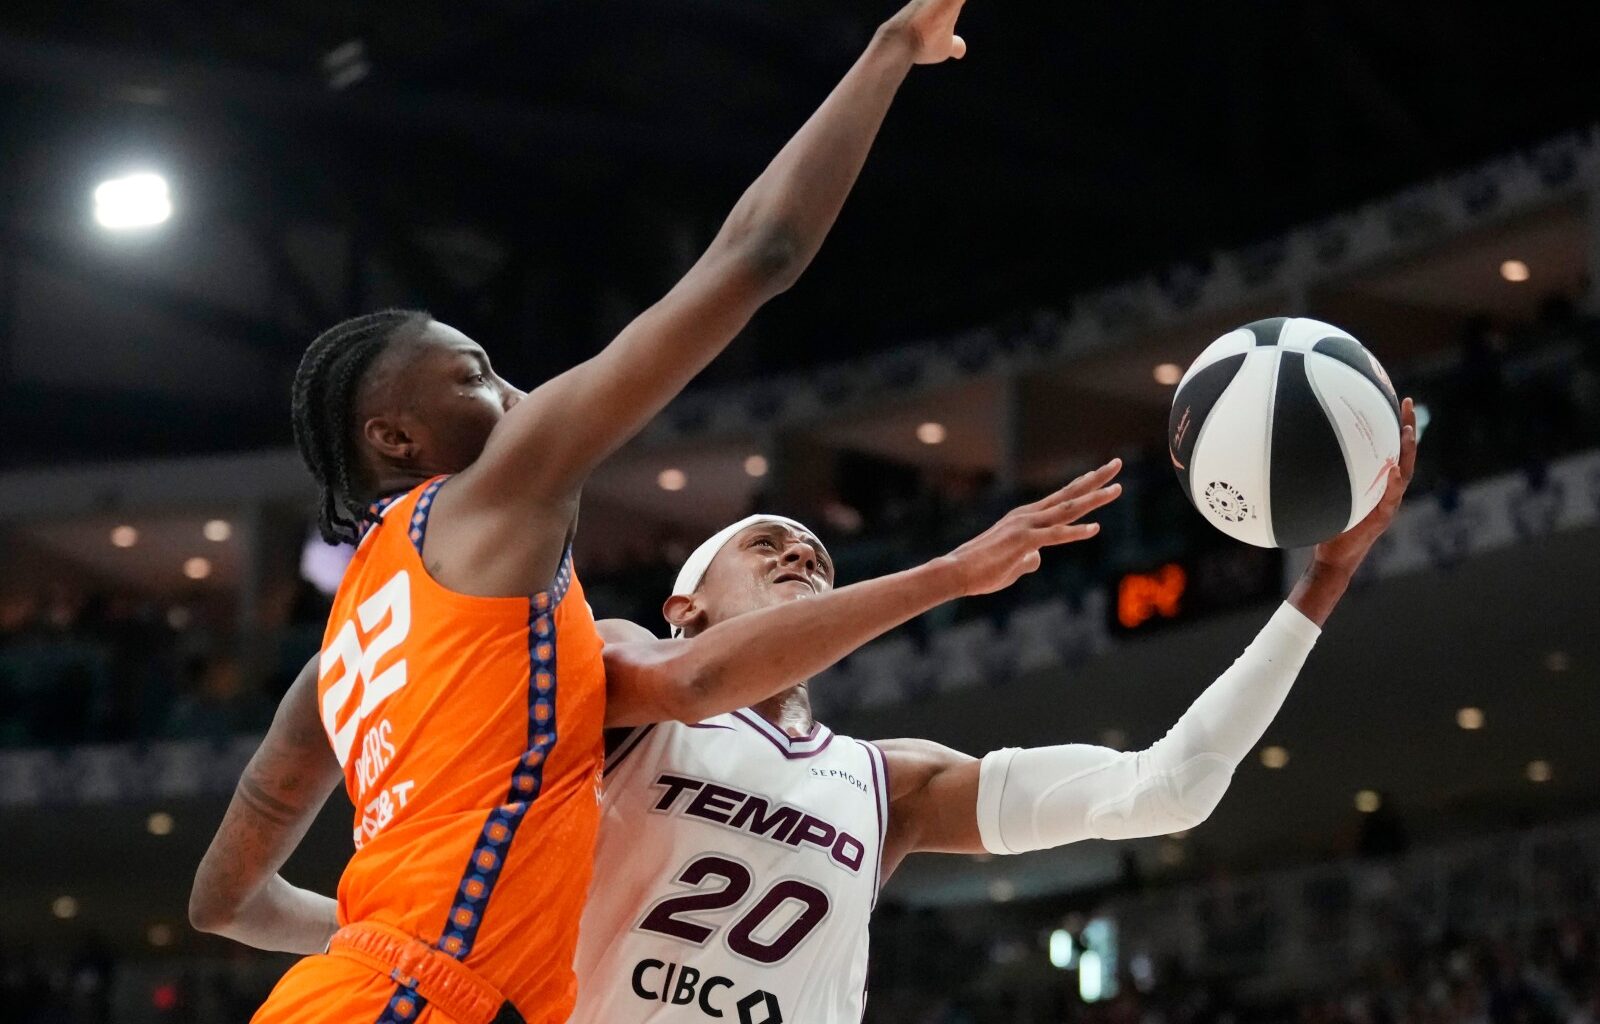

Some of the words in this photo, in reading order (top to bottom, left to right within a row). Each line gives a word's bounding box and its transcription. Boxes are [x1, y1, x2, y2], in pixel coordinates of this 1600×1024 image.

[320, 569, 411, 769] 22
[355, 719, 396, 797] VERS
[811, 768, 868, 793] SEPHORA
[653, 773, 866, 873] TEMPO
[638, 855, 830, 964] 20
[631, 958, 735, 1018] CIBC
